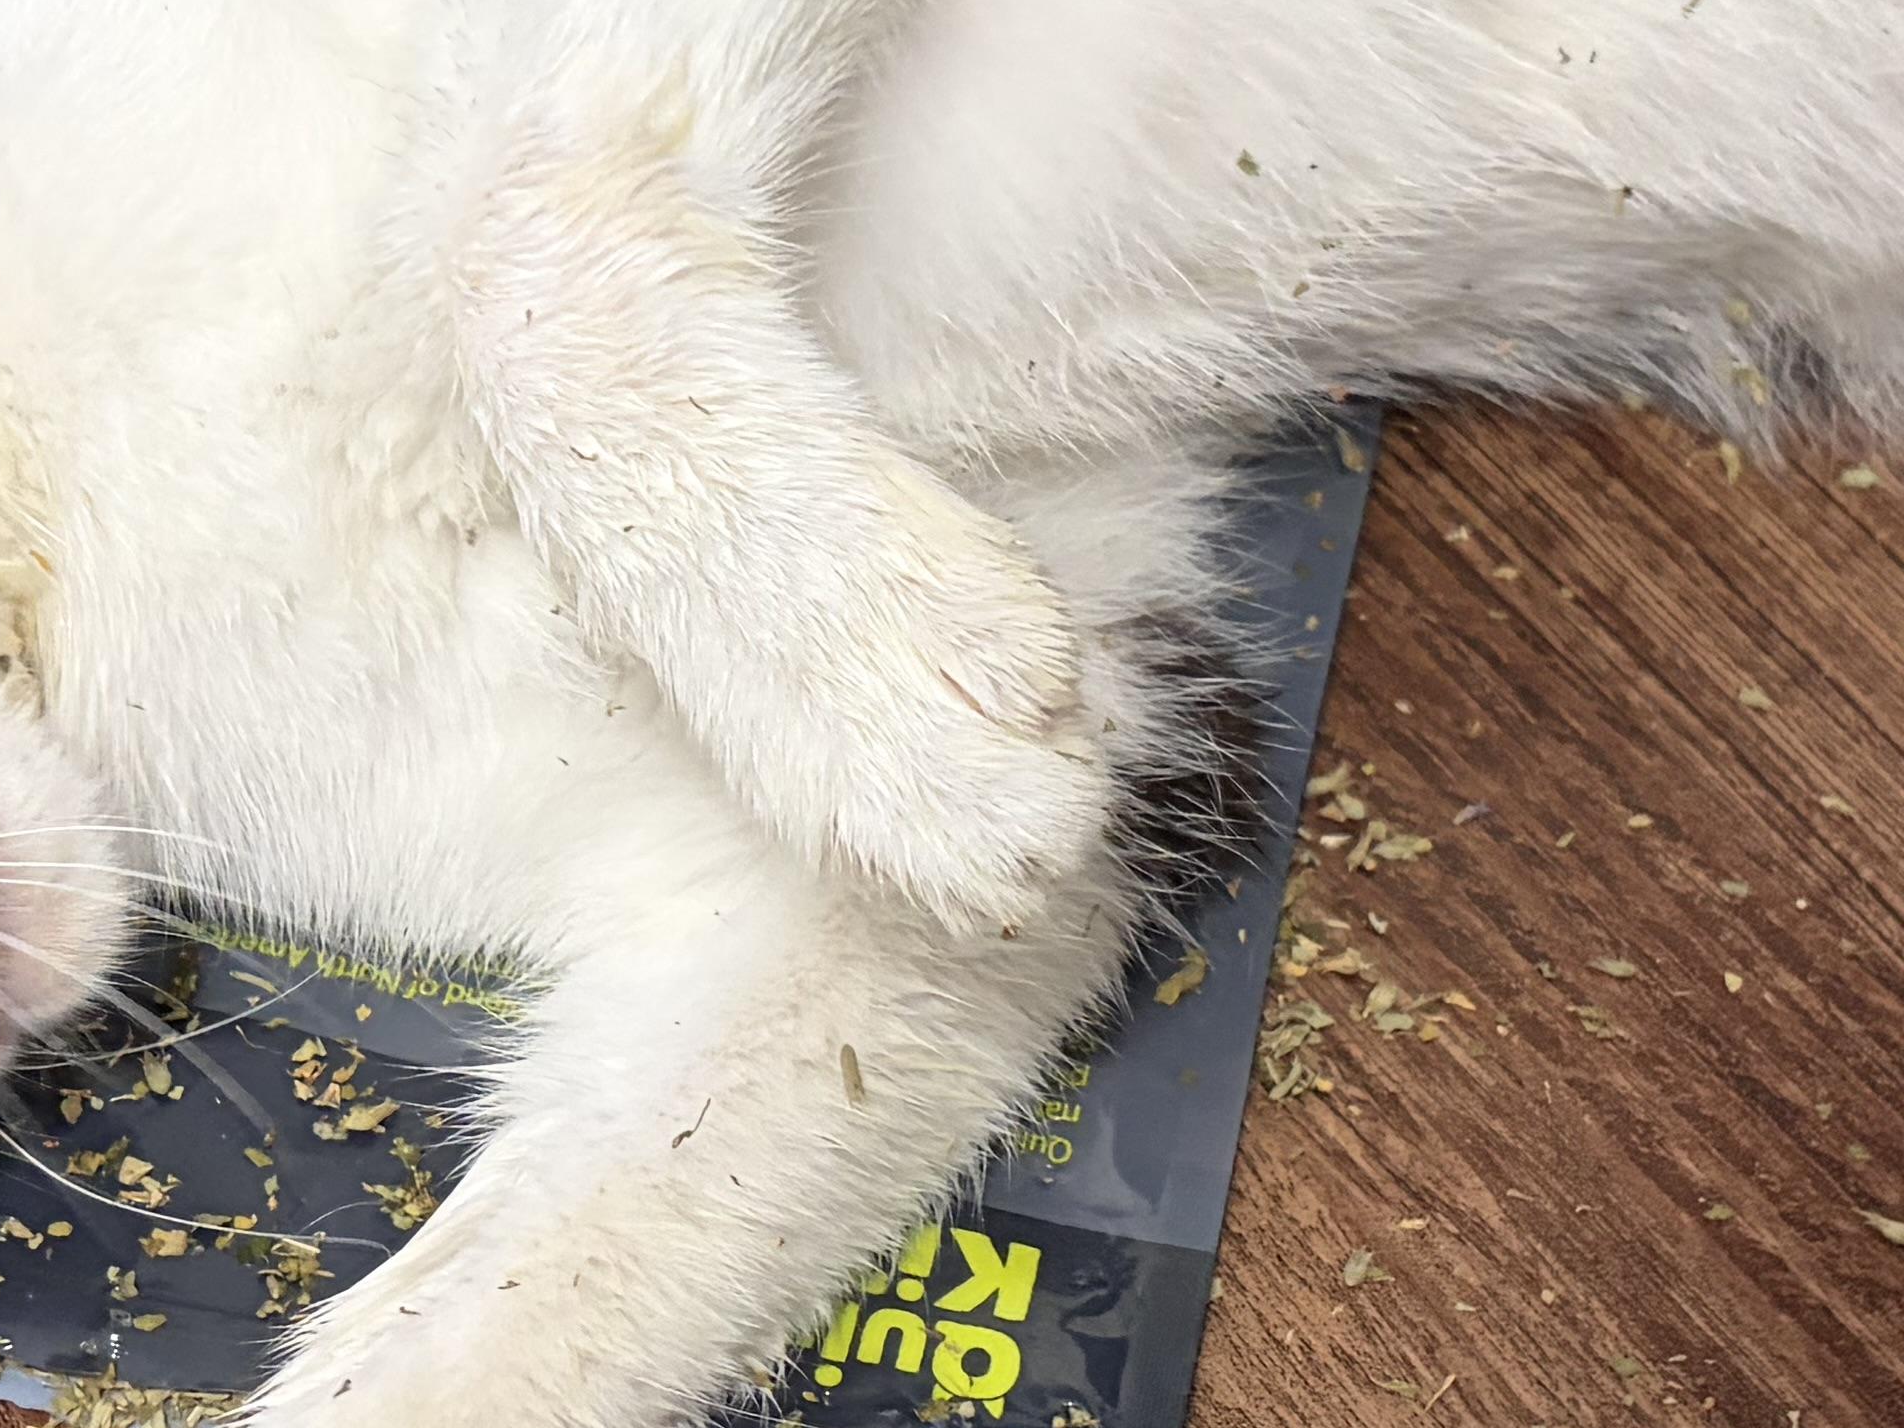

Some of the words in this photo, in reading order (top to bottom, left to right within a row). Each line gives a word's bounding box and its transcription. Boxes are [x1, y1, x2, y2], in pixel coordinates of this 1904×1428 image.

[317, 950, 398, 995] North
[858, 1226, 1041, 1323] Ki
[799, 1301, 1022, 1420] Qui
